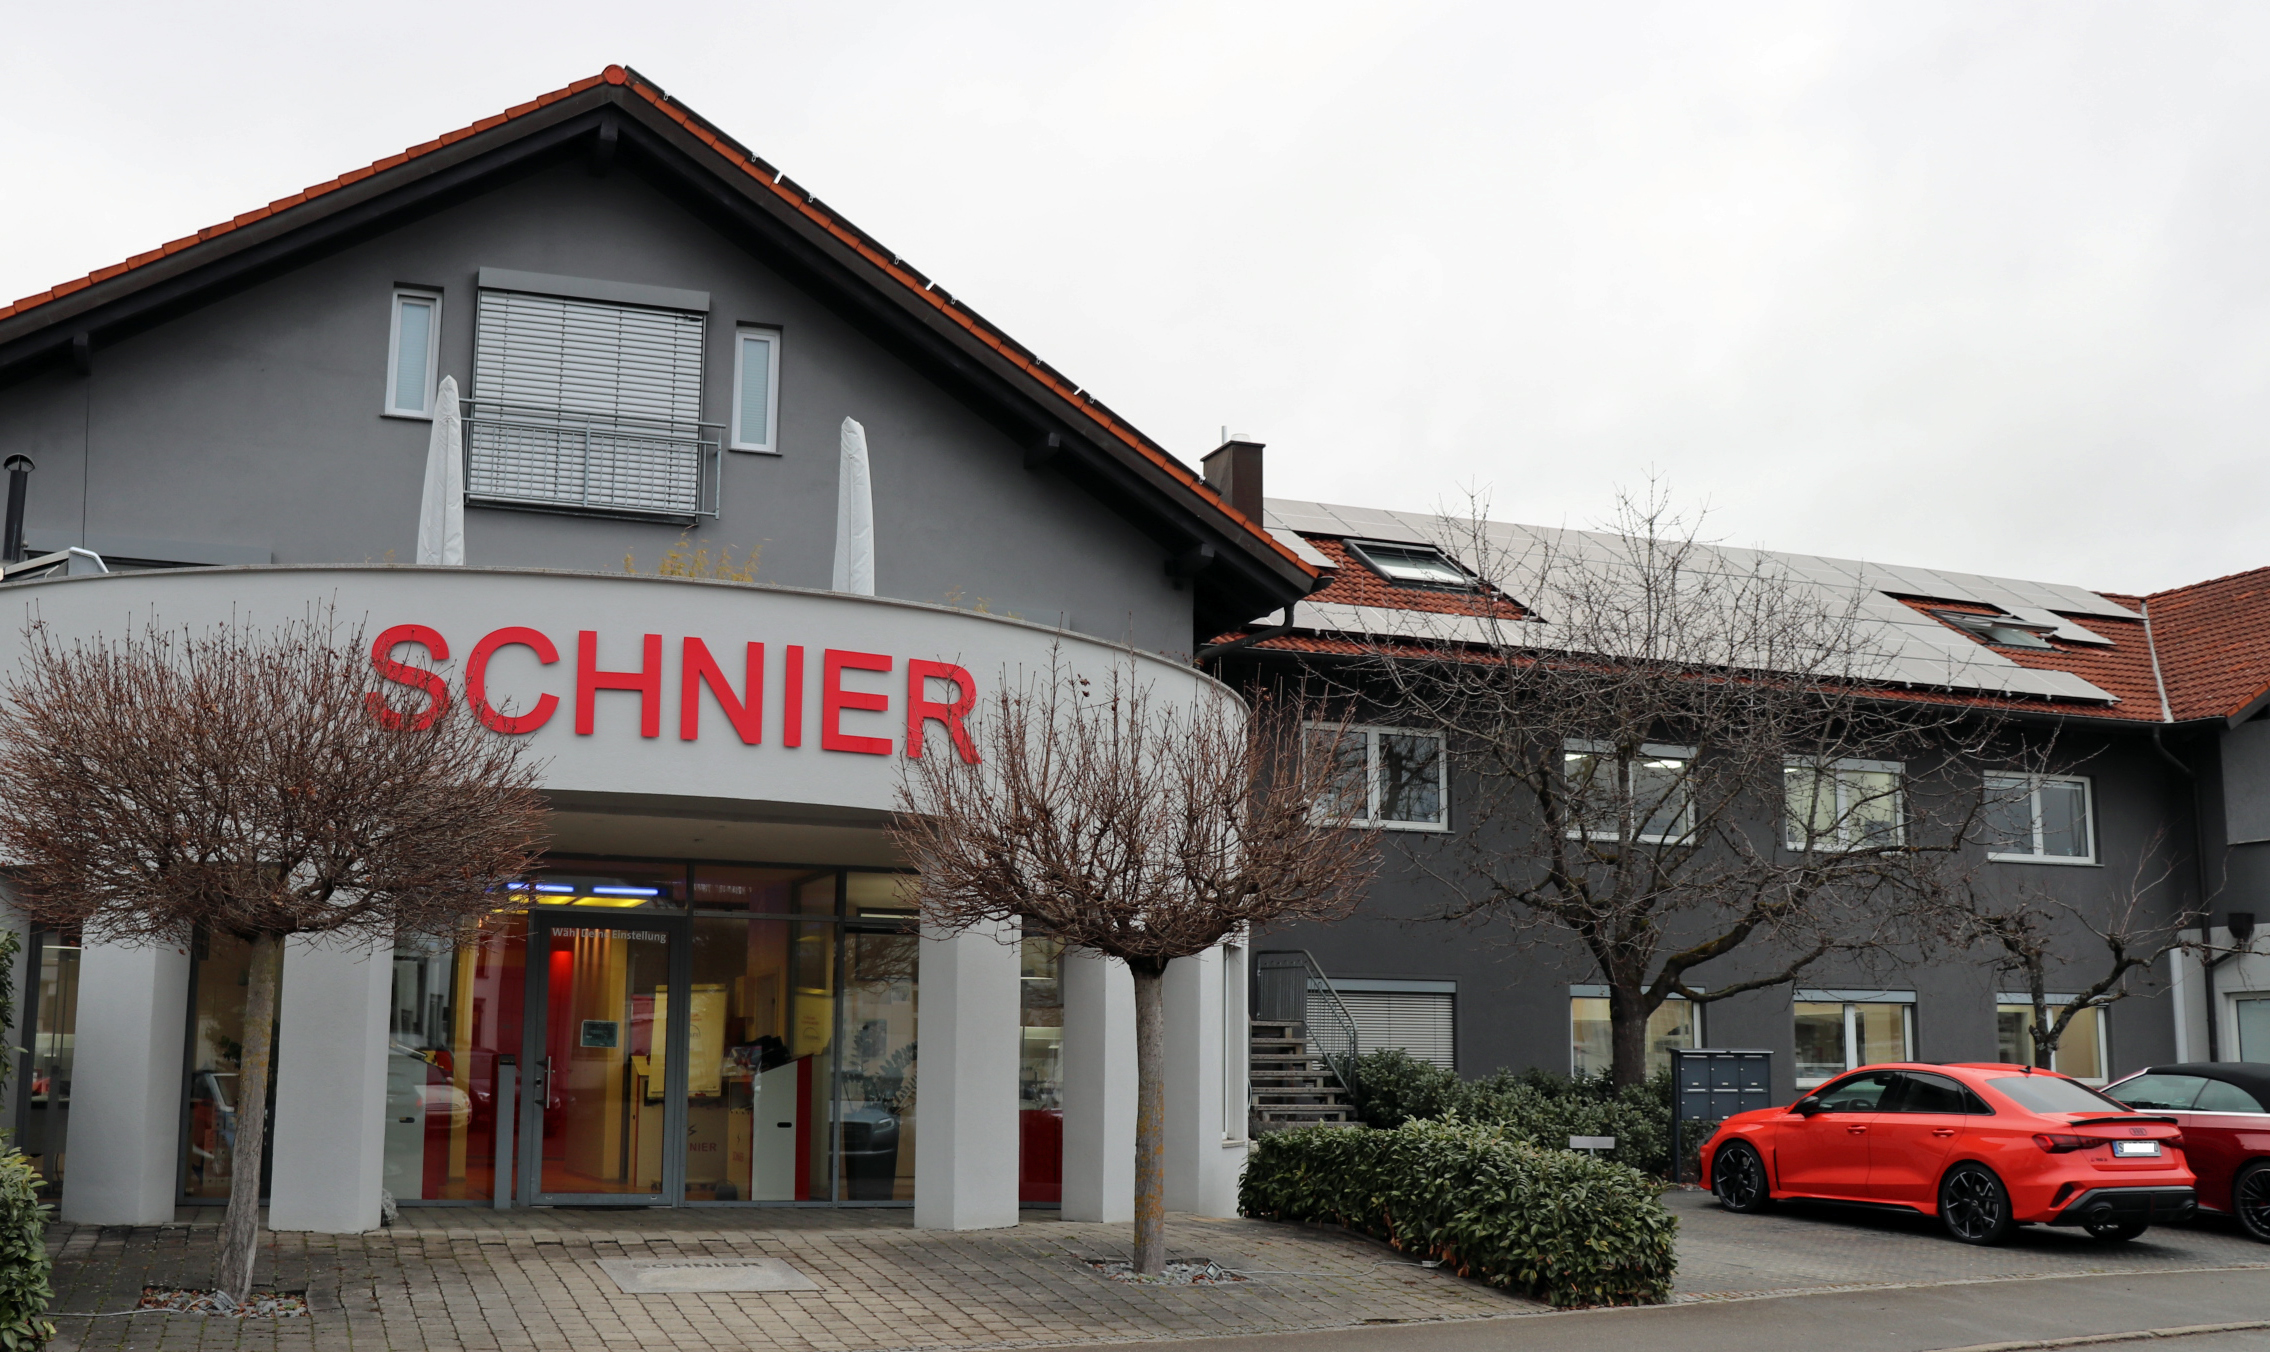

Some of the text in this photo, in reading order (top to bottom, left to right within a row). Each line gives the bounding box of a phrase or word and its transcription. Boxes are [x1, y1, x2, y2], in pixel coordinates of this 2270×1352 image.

[365, 624, 983, 765] SCHNIER
[552, 927, 667, 944] Wähl Deine Einstellung
[689, 1142, 717, 1152] NIER
